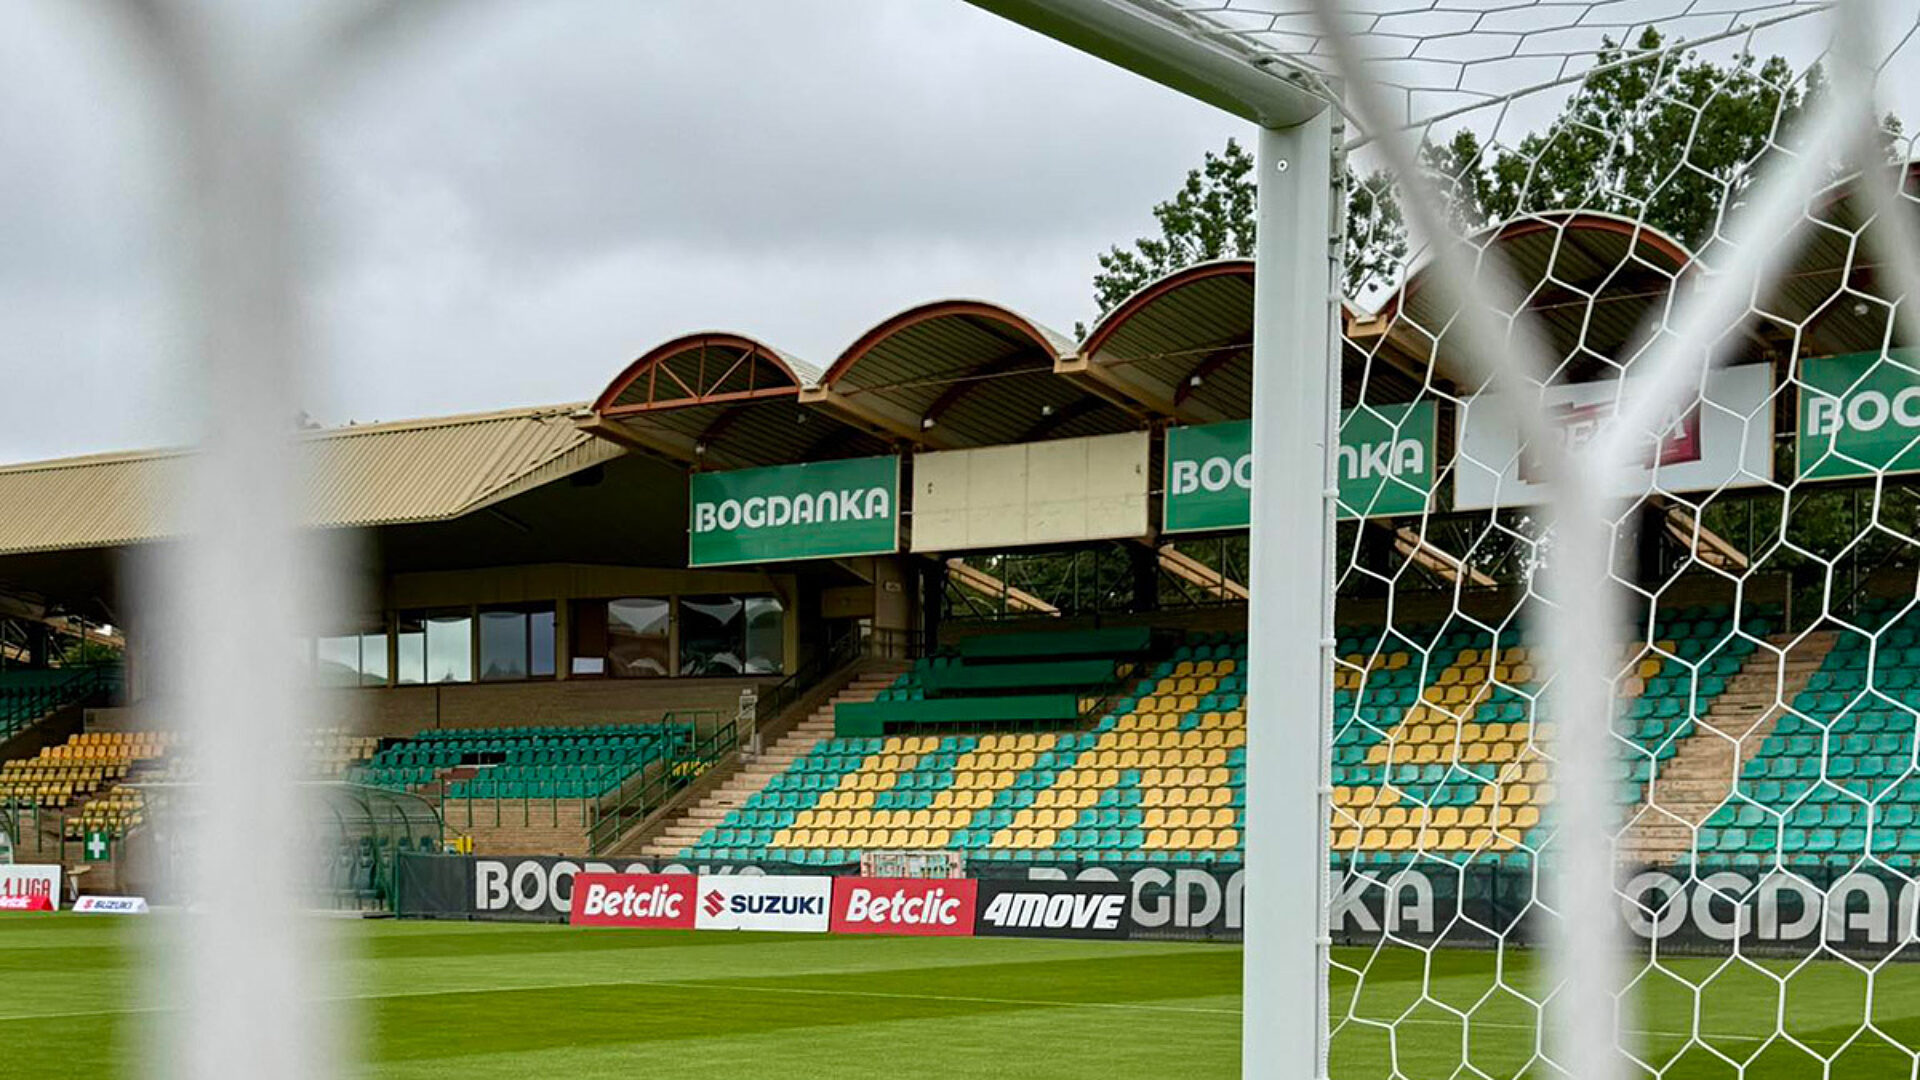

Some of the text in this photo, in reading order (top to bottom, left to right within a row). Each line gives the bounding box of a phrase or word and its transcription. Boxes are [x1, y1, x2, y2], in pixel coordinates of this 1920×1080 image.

[695, 487, 889, 532] BOGDANKA
[583, 883, 682, 918] Betclic
[730, 895, 823, 915] SUZUKI
[845, 888, 960, 925] Betclic
[983, 893, 1126, 929] 4MOVE
